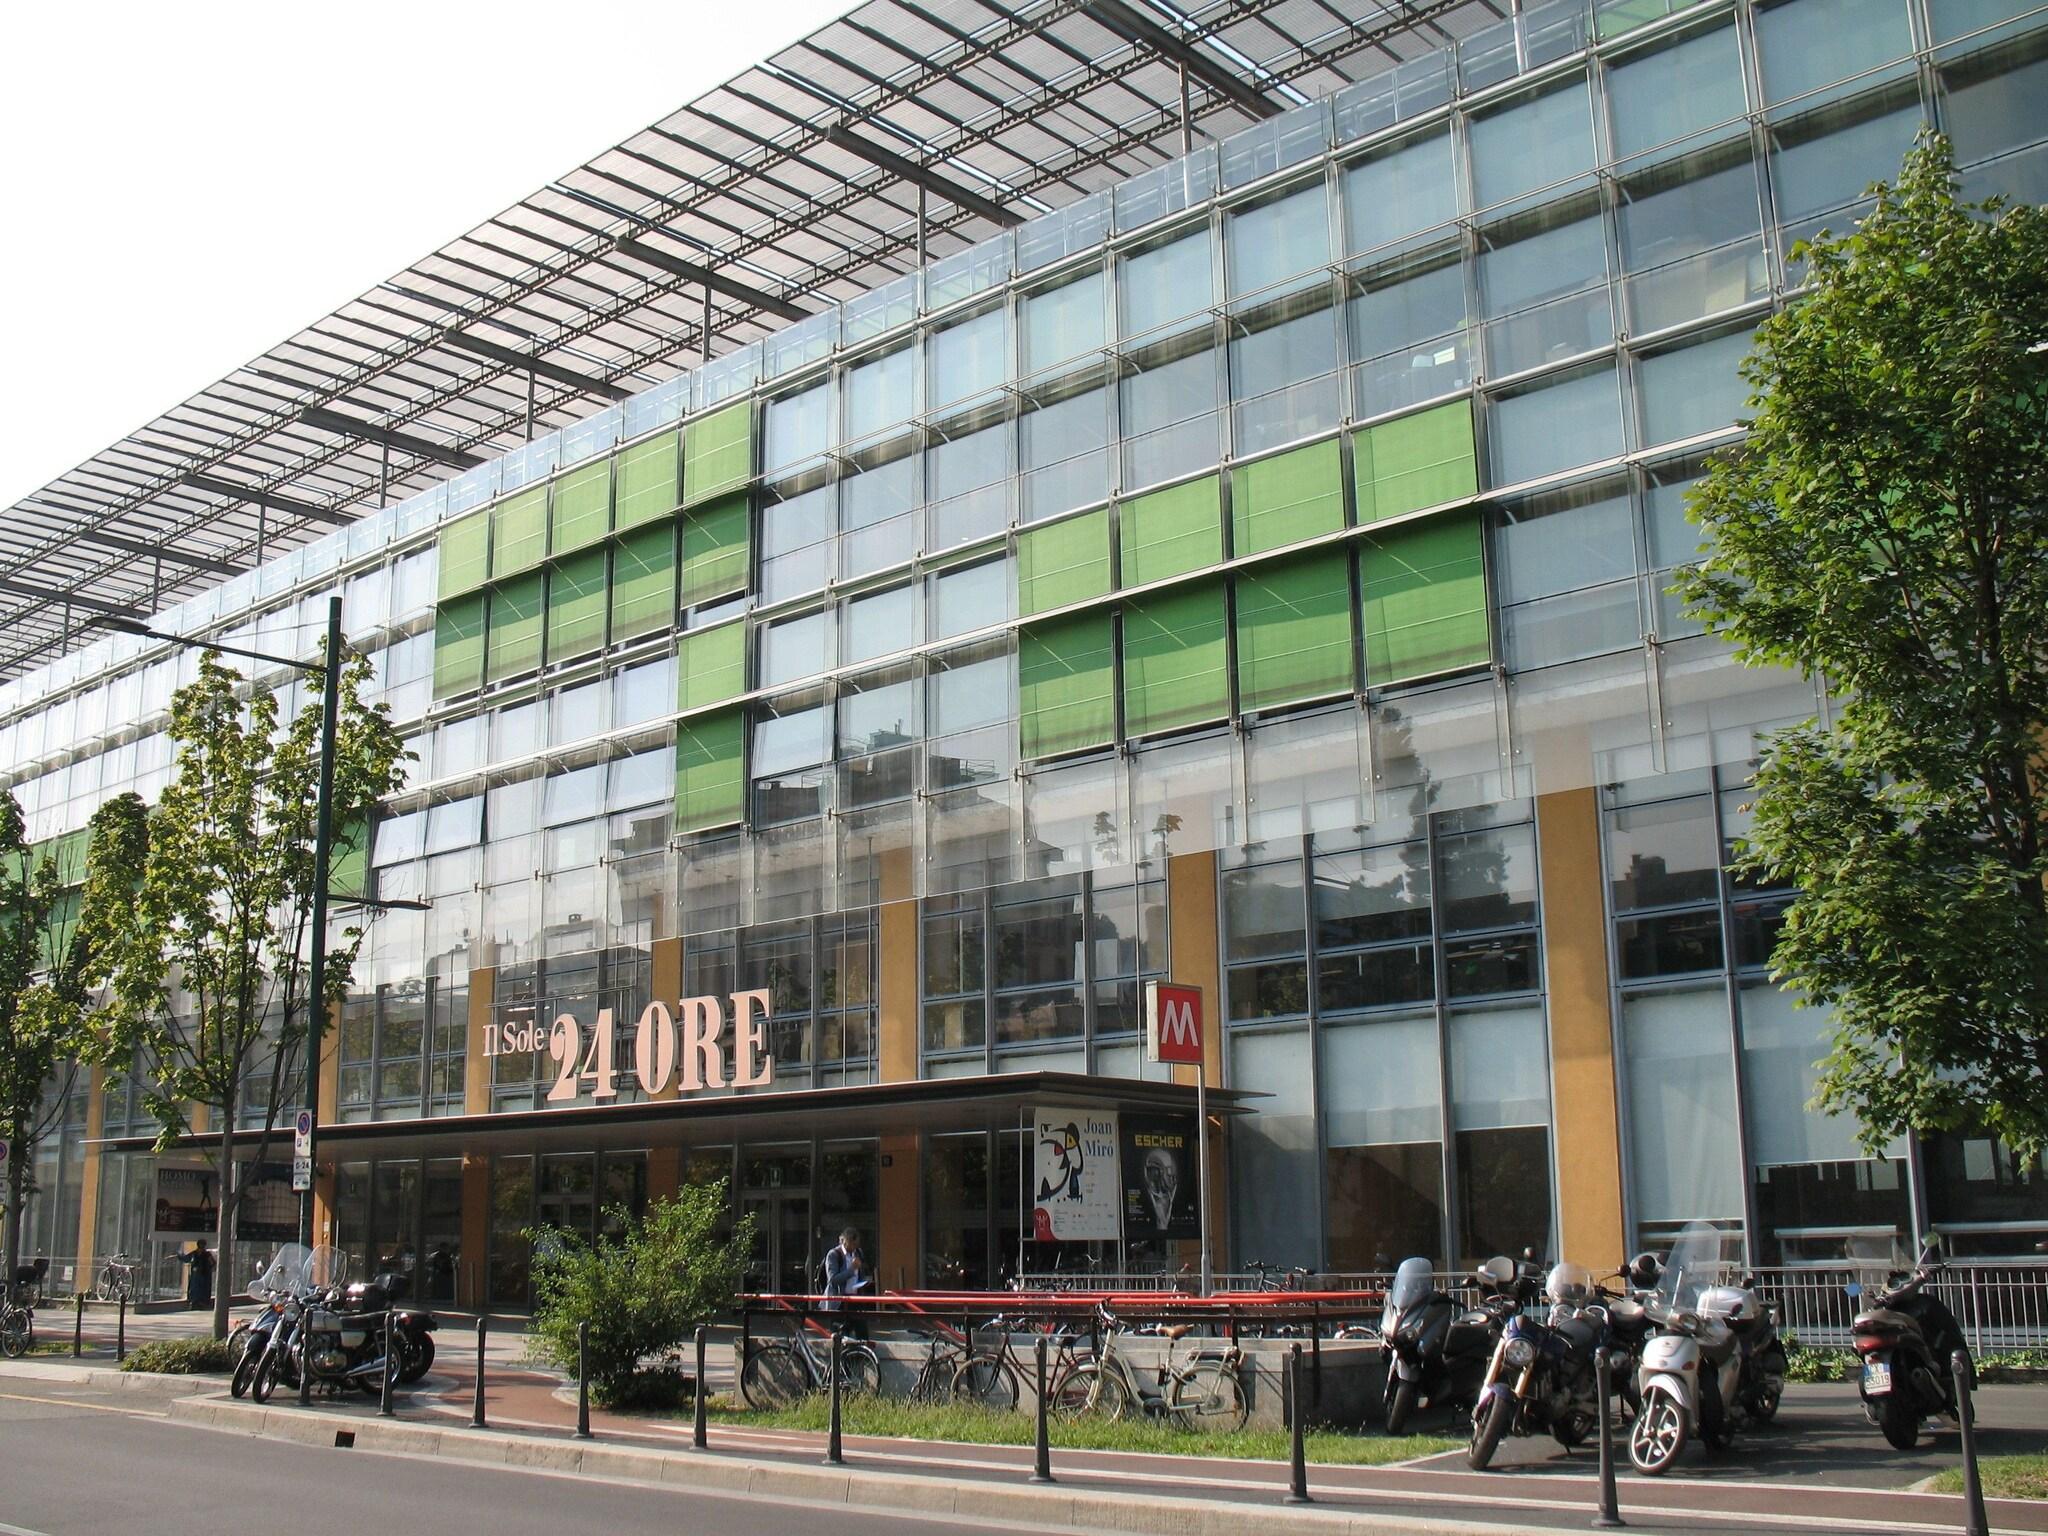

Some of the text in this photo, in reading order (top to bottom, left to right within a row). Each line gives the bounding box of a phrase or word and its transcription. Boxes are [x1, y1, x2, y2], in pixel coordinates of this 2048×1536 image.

[1161, 999, 1199, 1047] M
[482, 988, 772, 1101] Il Sole 24 ORE
[1084, 1117, 1112, 1135] Joan
[1085, 1139, 1114, 1157] Miró
[1135, 1135, 1183, 1148] ESCHER
